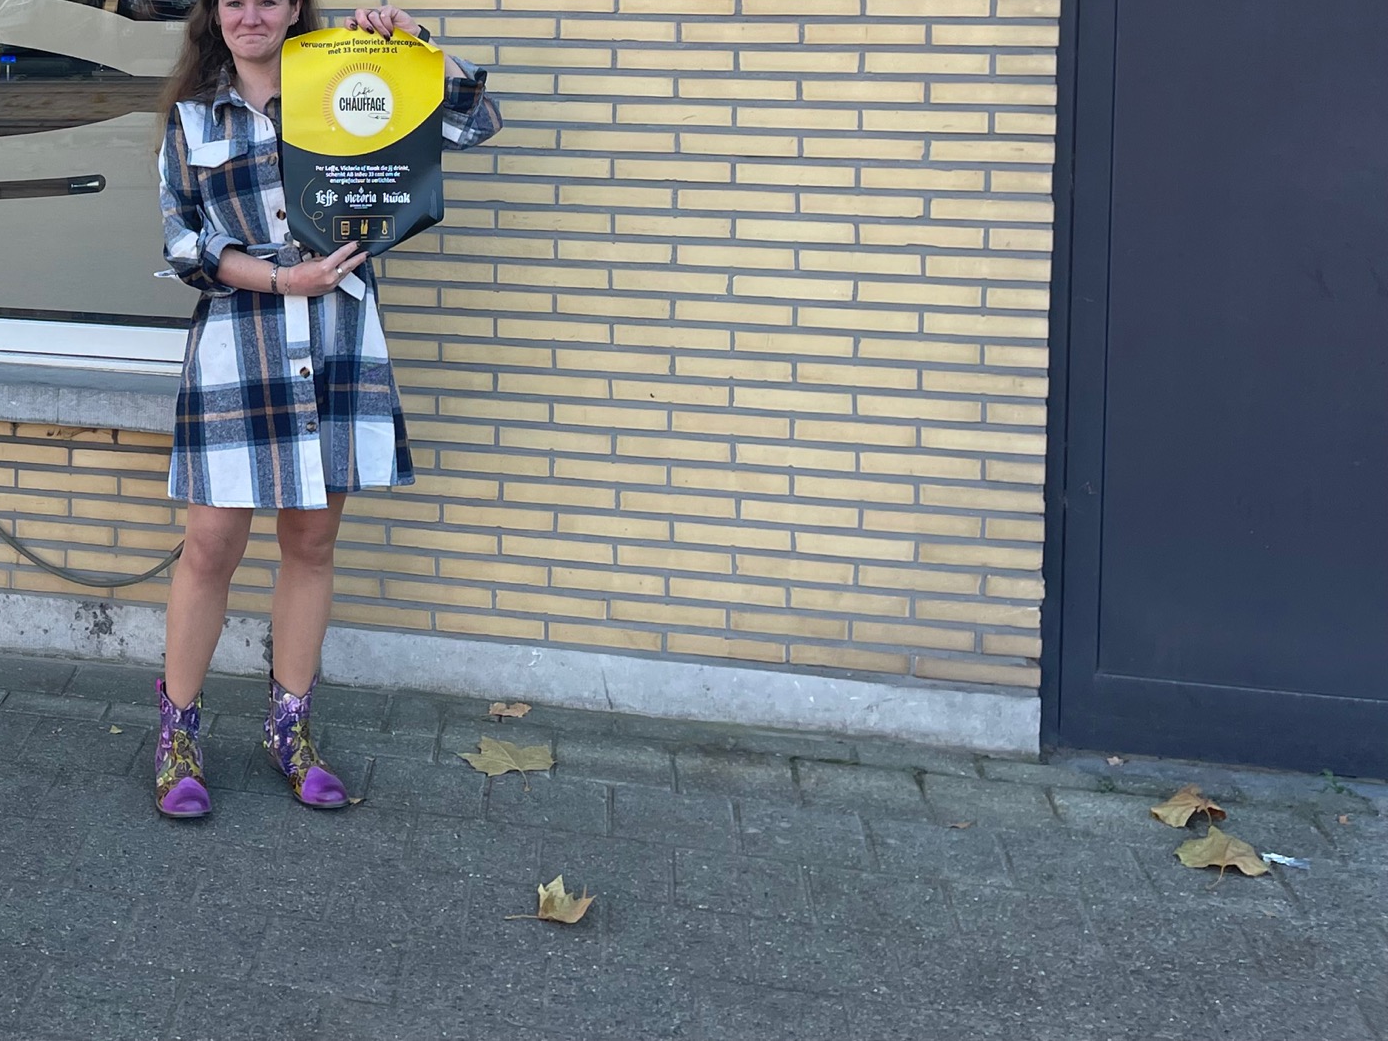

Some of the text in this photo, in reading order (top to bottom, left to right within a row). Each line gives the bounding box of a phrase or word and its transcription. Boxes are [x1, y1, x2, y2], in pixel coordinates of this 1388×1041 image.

[333, 39, 351, 49] jouw
[352, 38, 385, 47] favoriete
[328, 47, 341, 55] met
[369, 46, 380, 54] per
[391, 46, 398, 54] cl
[339, 97, 386, 111] CHAUFFAGE
[315, 189, 339, 207] Leffe
